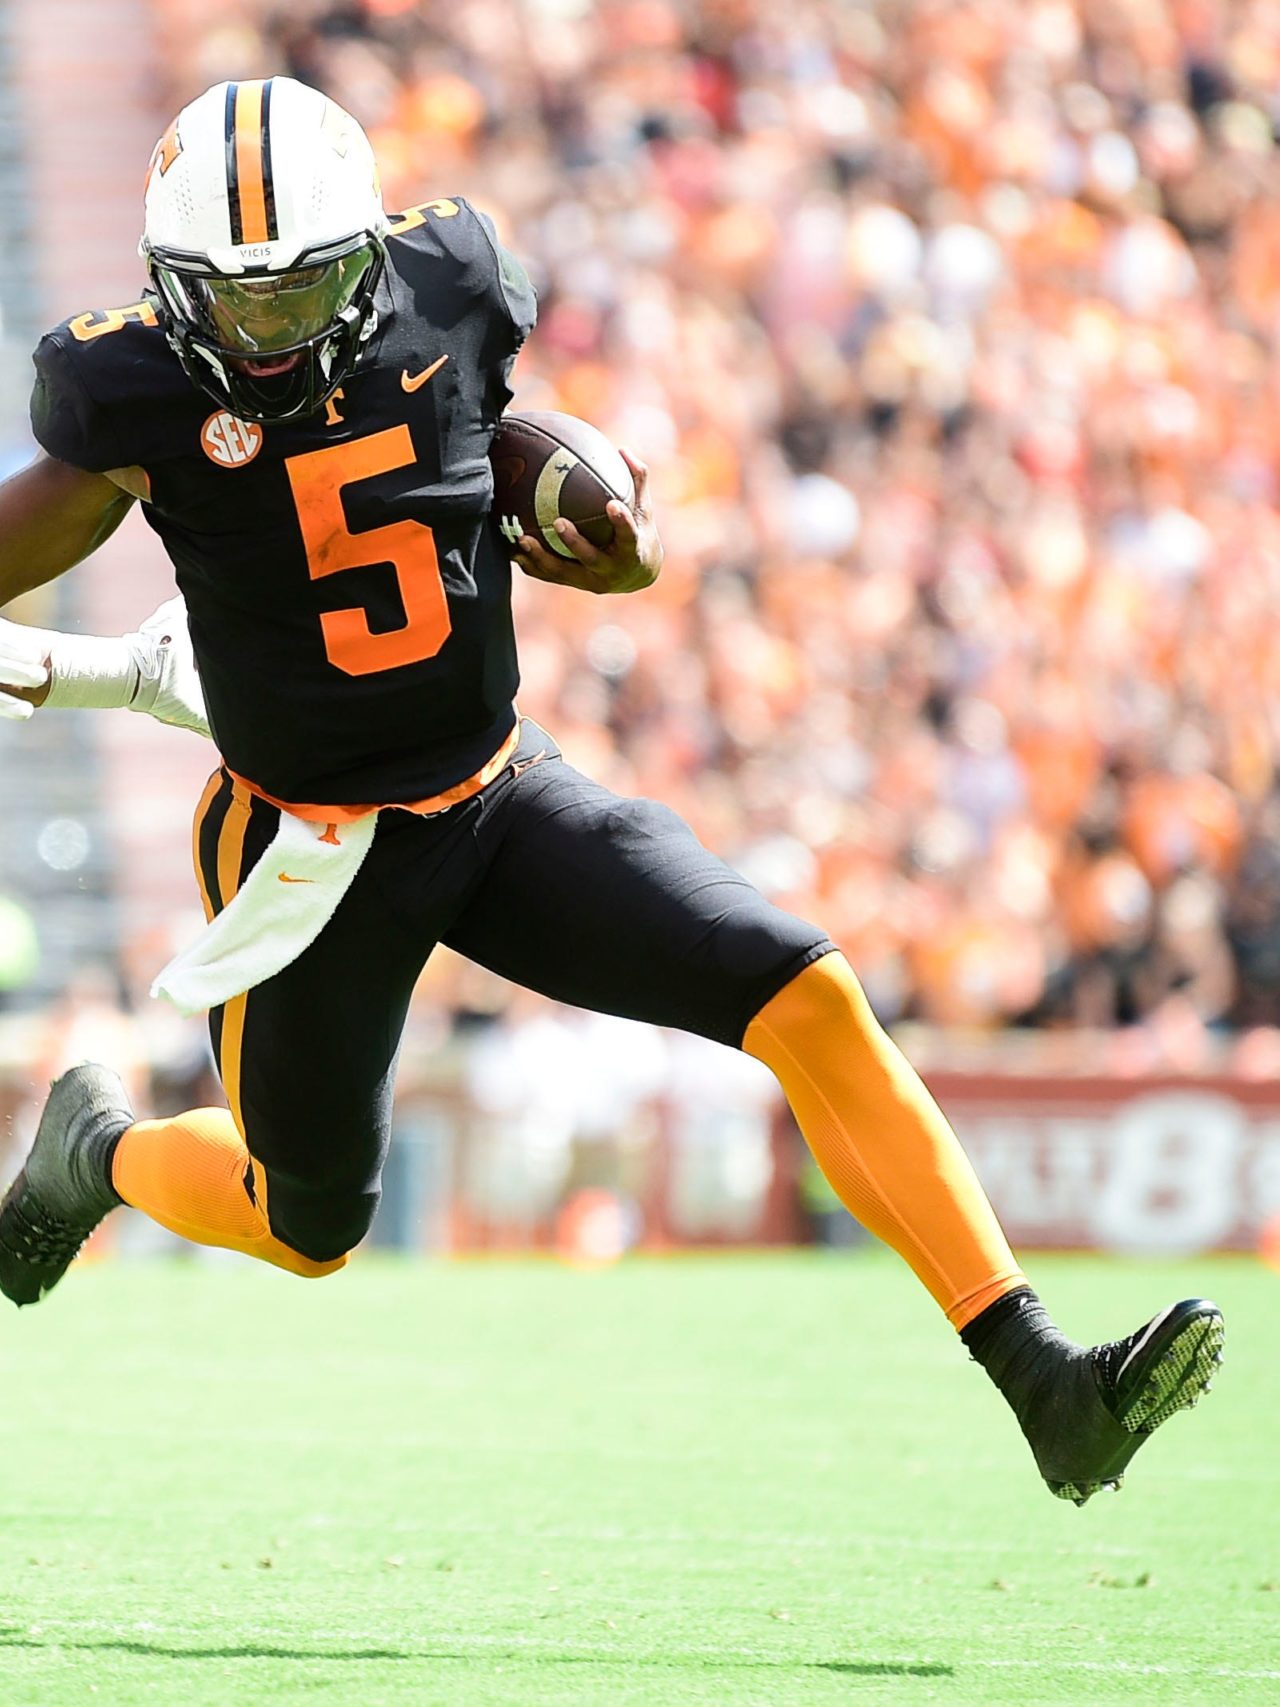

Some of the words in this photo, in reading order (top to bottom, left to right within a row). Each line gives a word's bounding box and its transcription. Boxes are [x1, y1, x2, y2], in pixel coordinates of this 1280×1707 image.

[240, 247, 271, 257] VICIS
[68, 301, 159, 341] 5
[206, 412, 259, 463] SEC
[285, 424, 452, 677] 5
